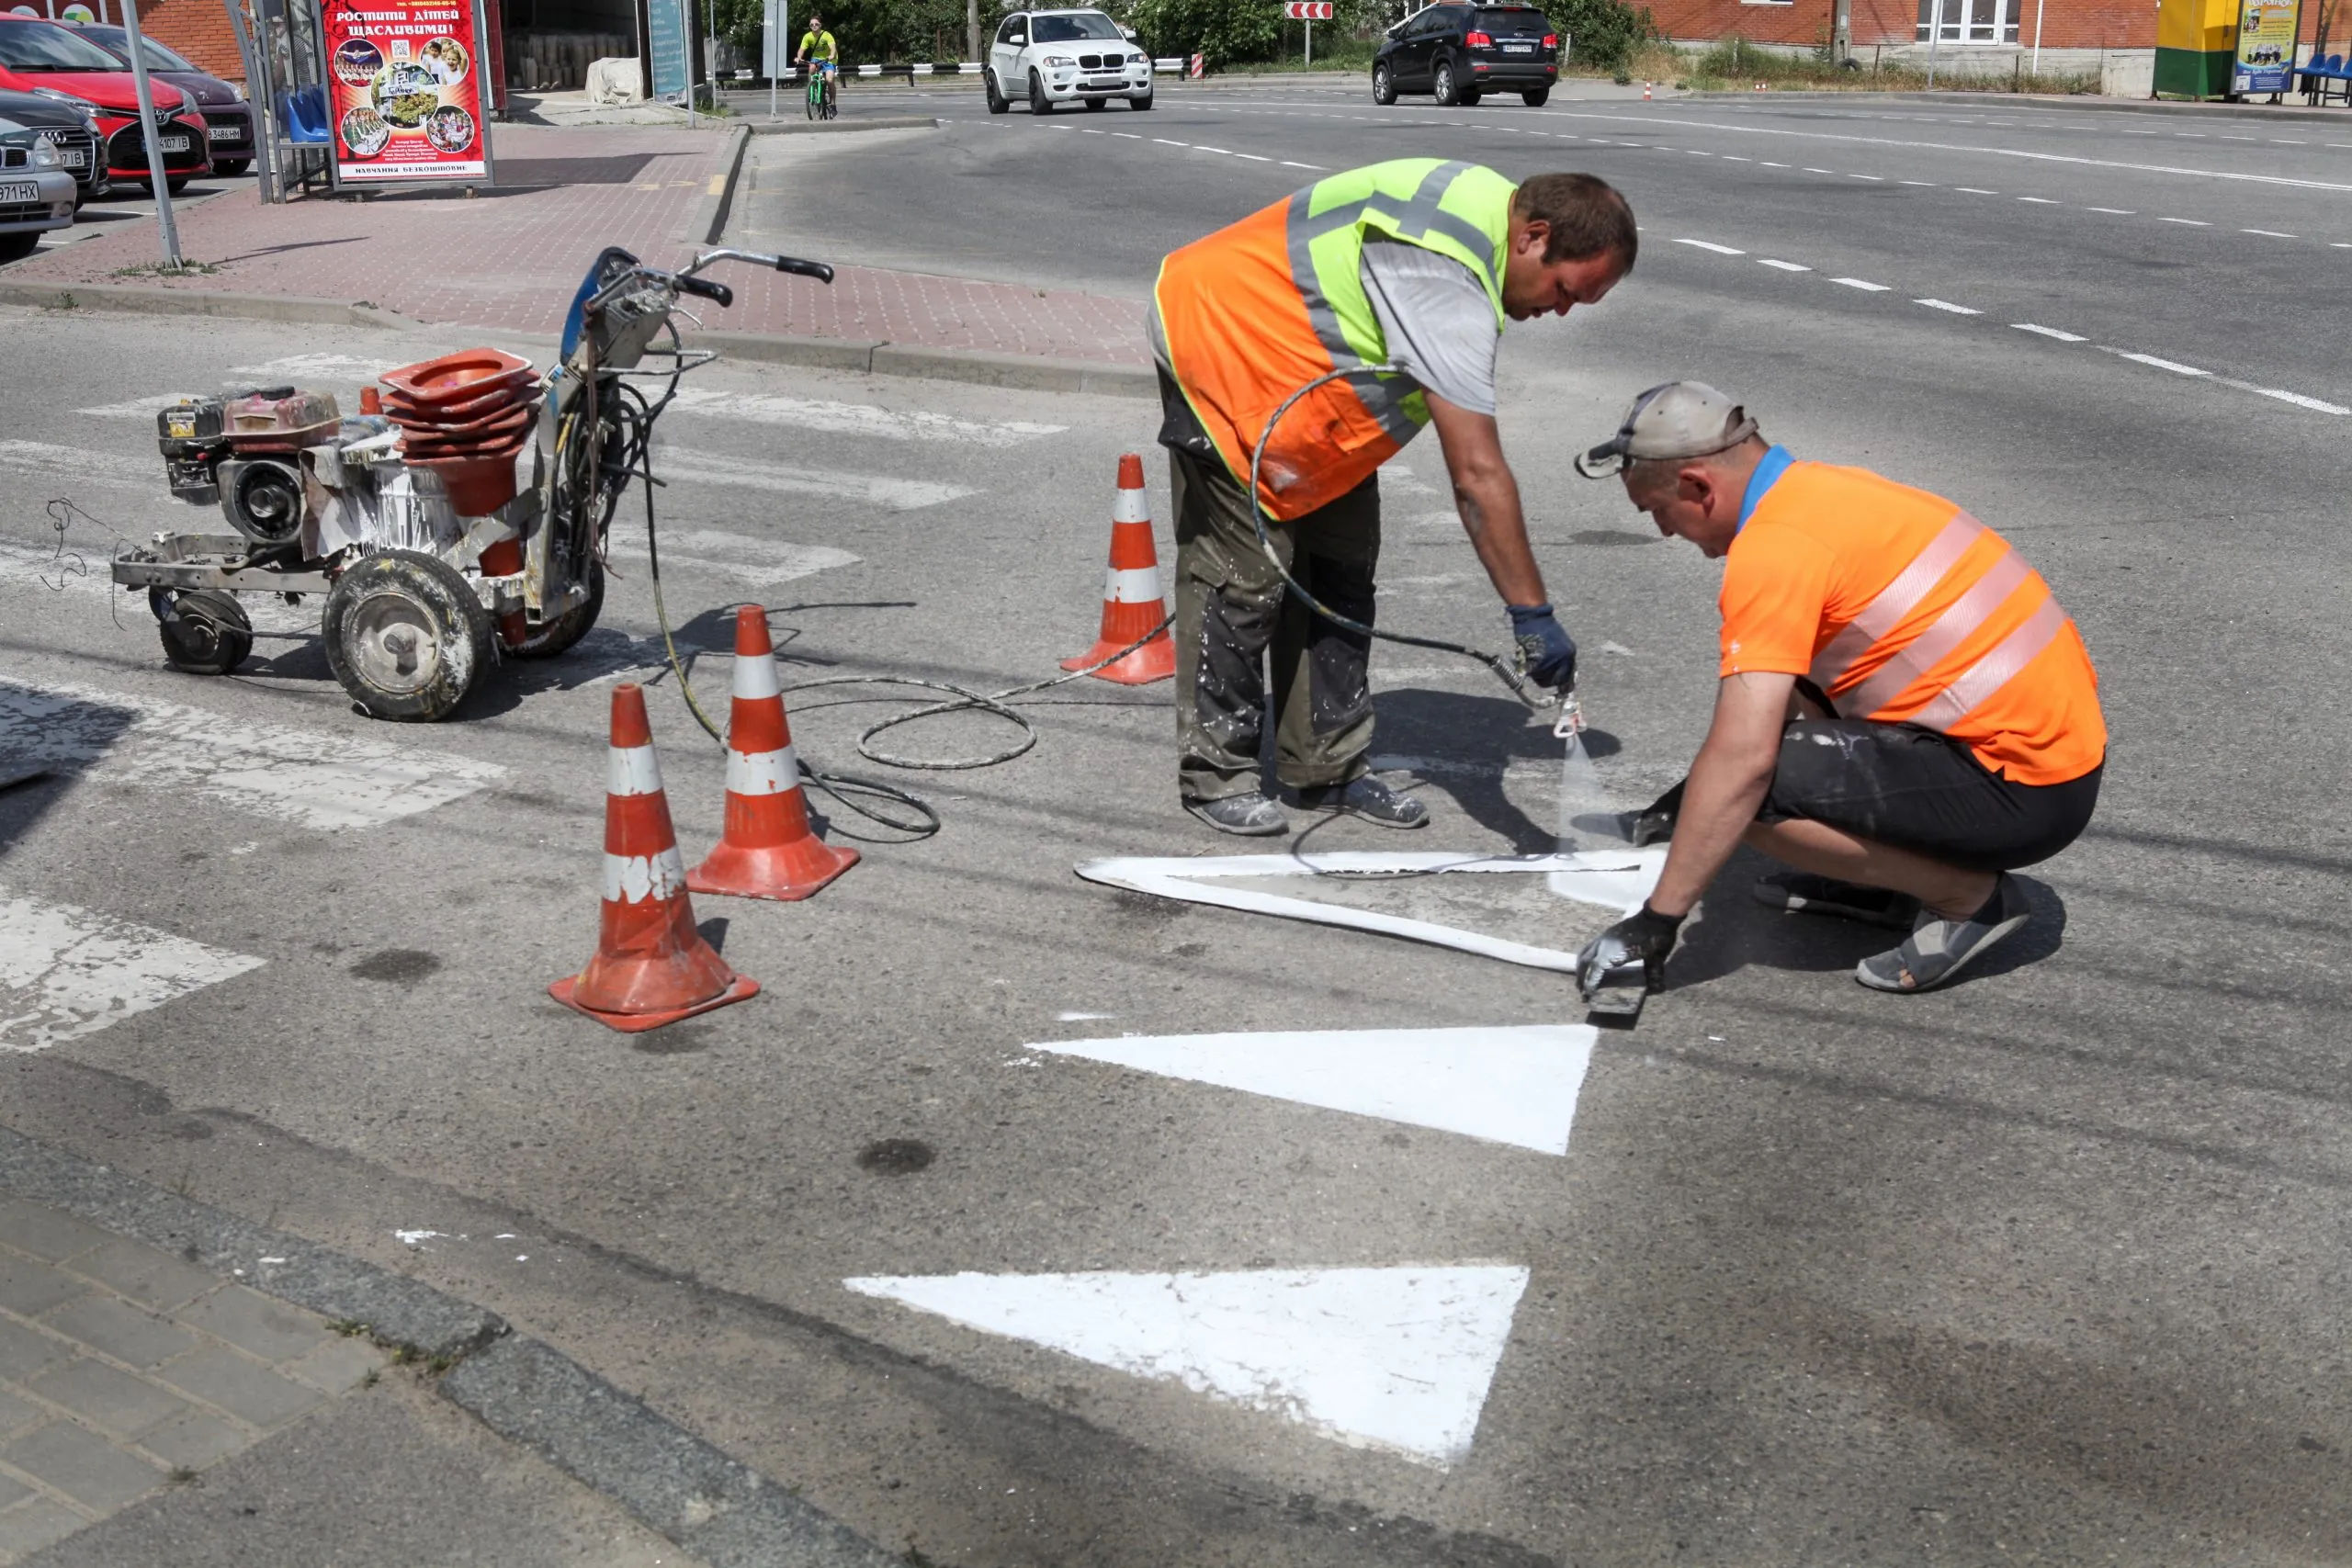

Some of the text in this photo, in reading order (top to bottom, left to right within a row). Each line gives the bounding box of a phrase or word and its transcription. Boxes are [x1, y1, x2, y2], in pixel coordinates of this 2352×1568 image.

[336, 9, 459, 22] РОСТИТИ ДІТЕЙ
[348, 24, 454, 38] ЩАСЛИВИМИ!
[212, 130, 229, 139] 3486
[229, 130, 240, 138] HM
[178, 138, 188, 148] IB
[71, 152, 82, 164] IB
[18, 185, 36, 199] HX
